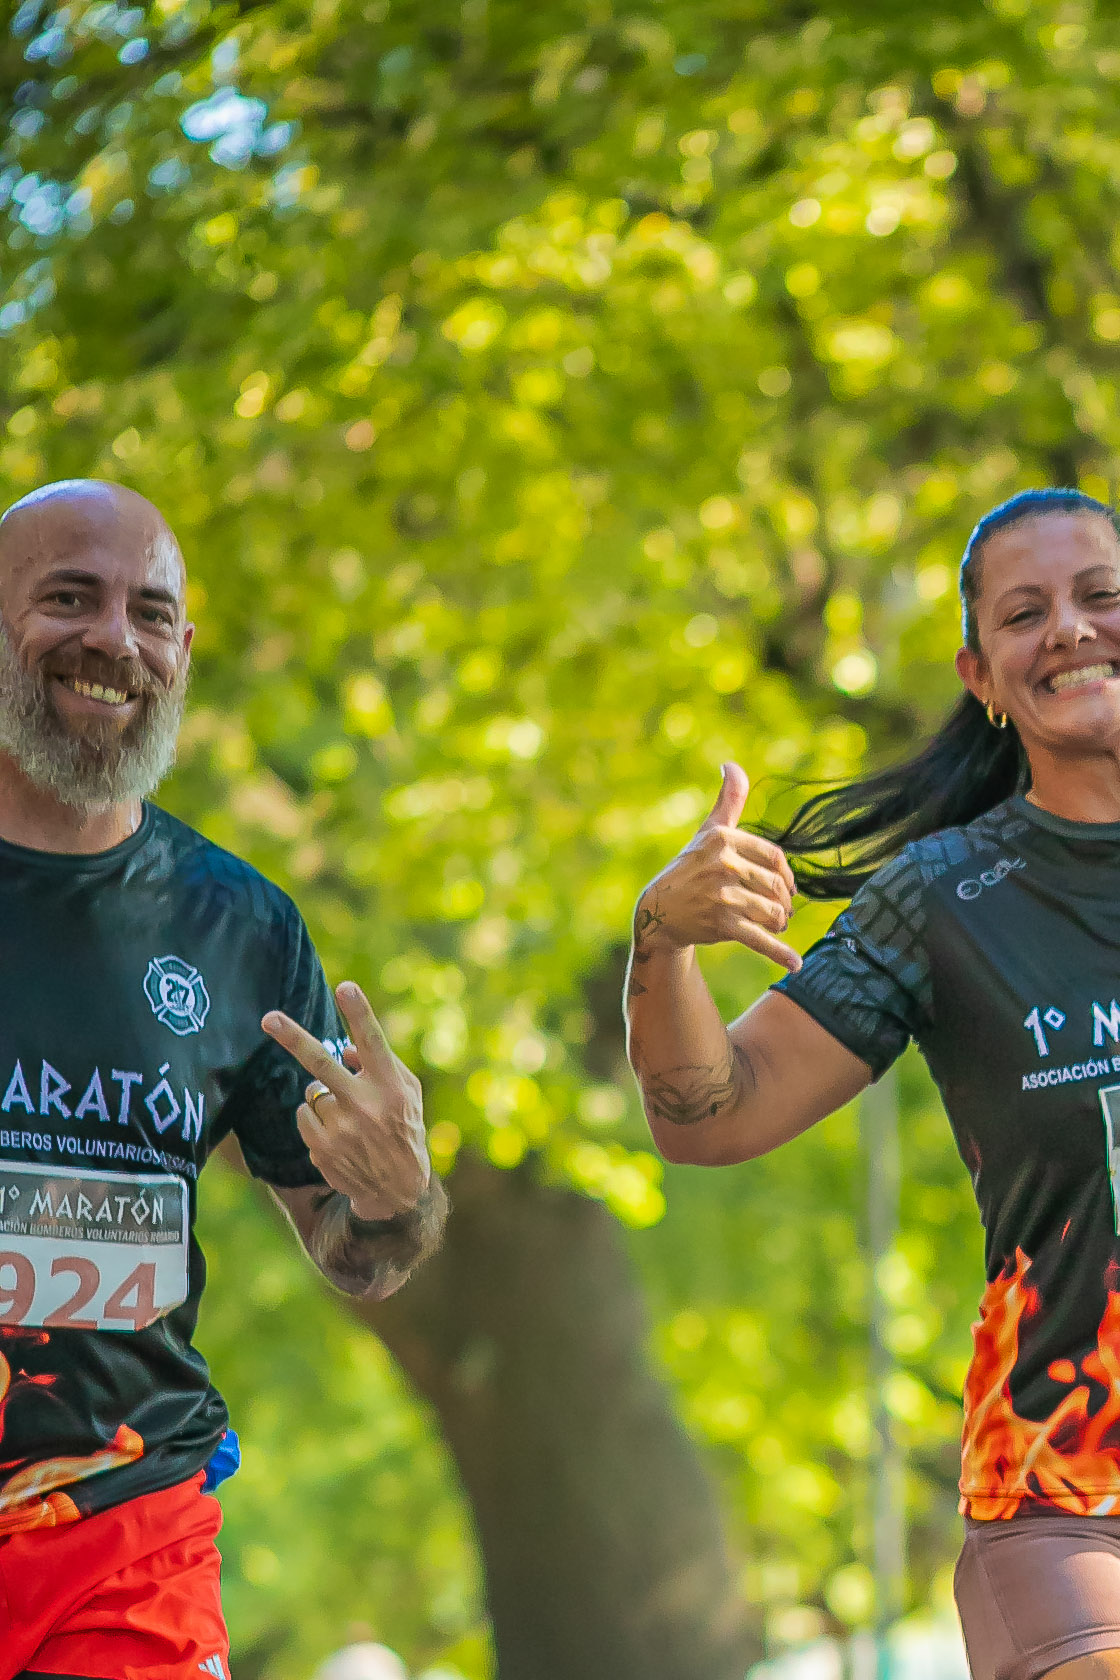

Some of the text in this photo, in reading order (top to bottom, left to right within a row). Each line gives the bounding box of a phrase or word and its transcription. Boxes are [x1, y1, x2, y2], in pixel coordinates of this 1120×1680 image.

[1022, 1057, 1110, 1091] ASOCIACIÓN
[56, 1134, 160, 1166] VOLUNTARIOS
[29, 1188, 164, 1225] MARATÓN
[86, 1226, 149, 1243] VOLUNTARIOS
[0, 1250, 161, 1332] 924
